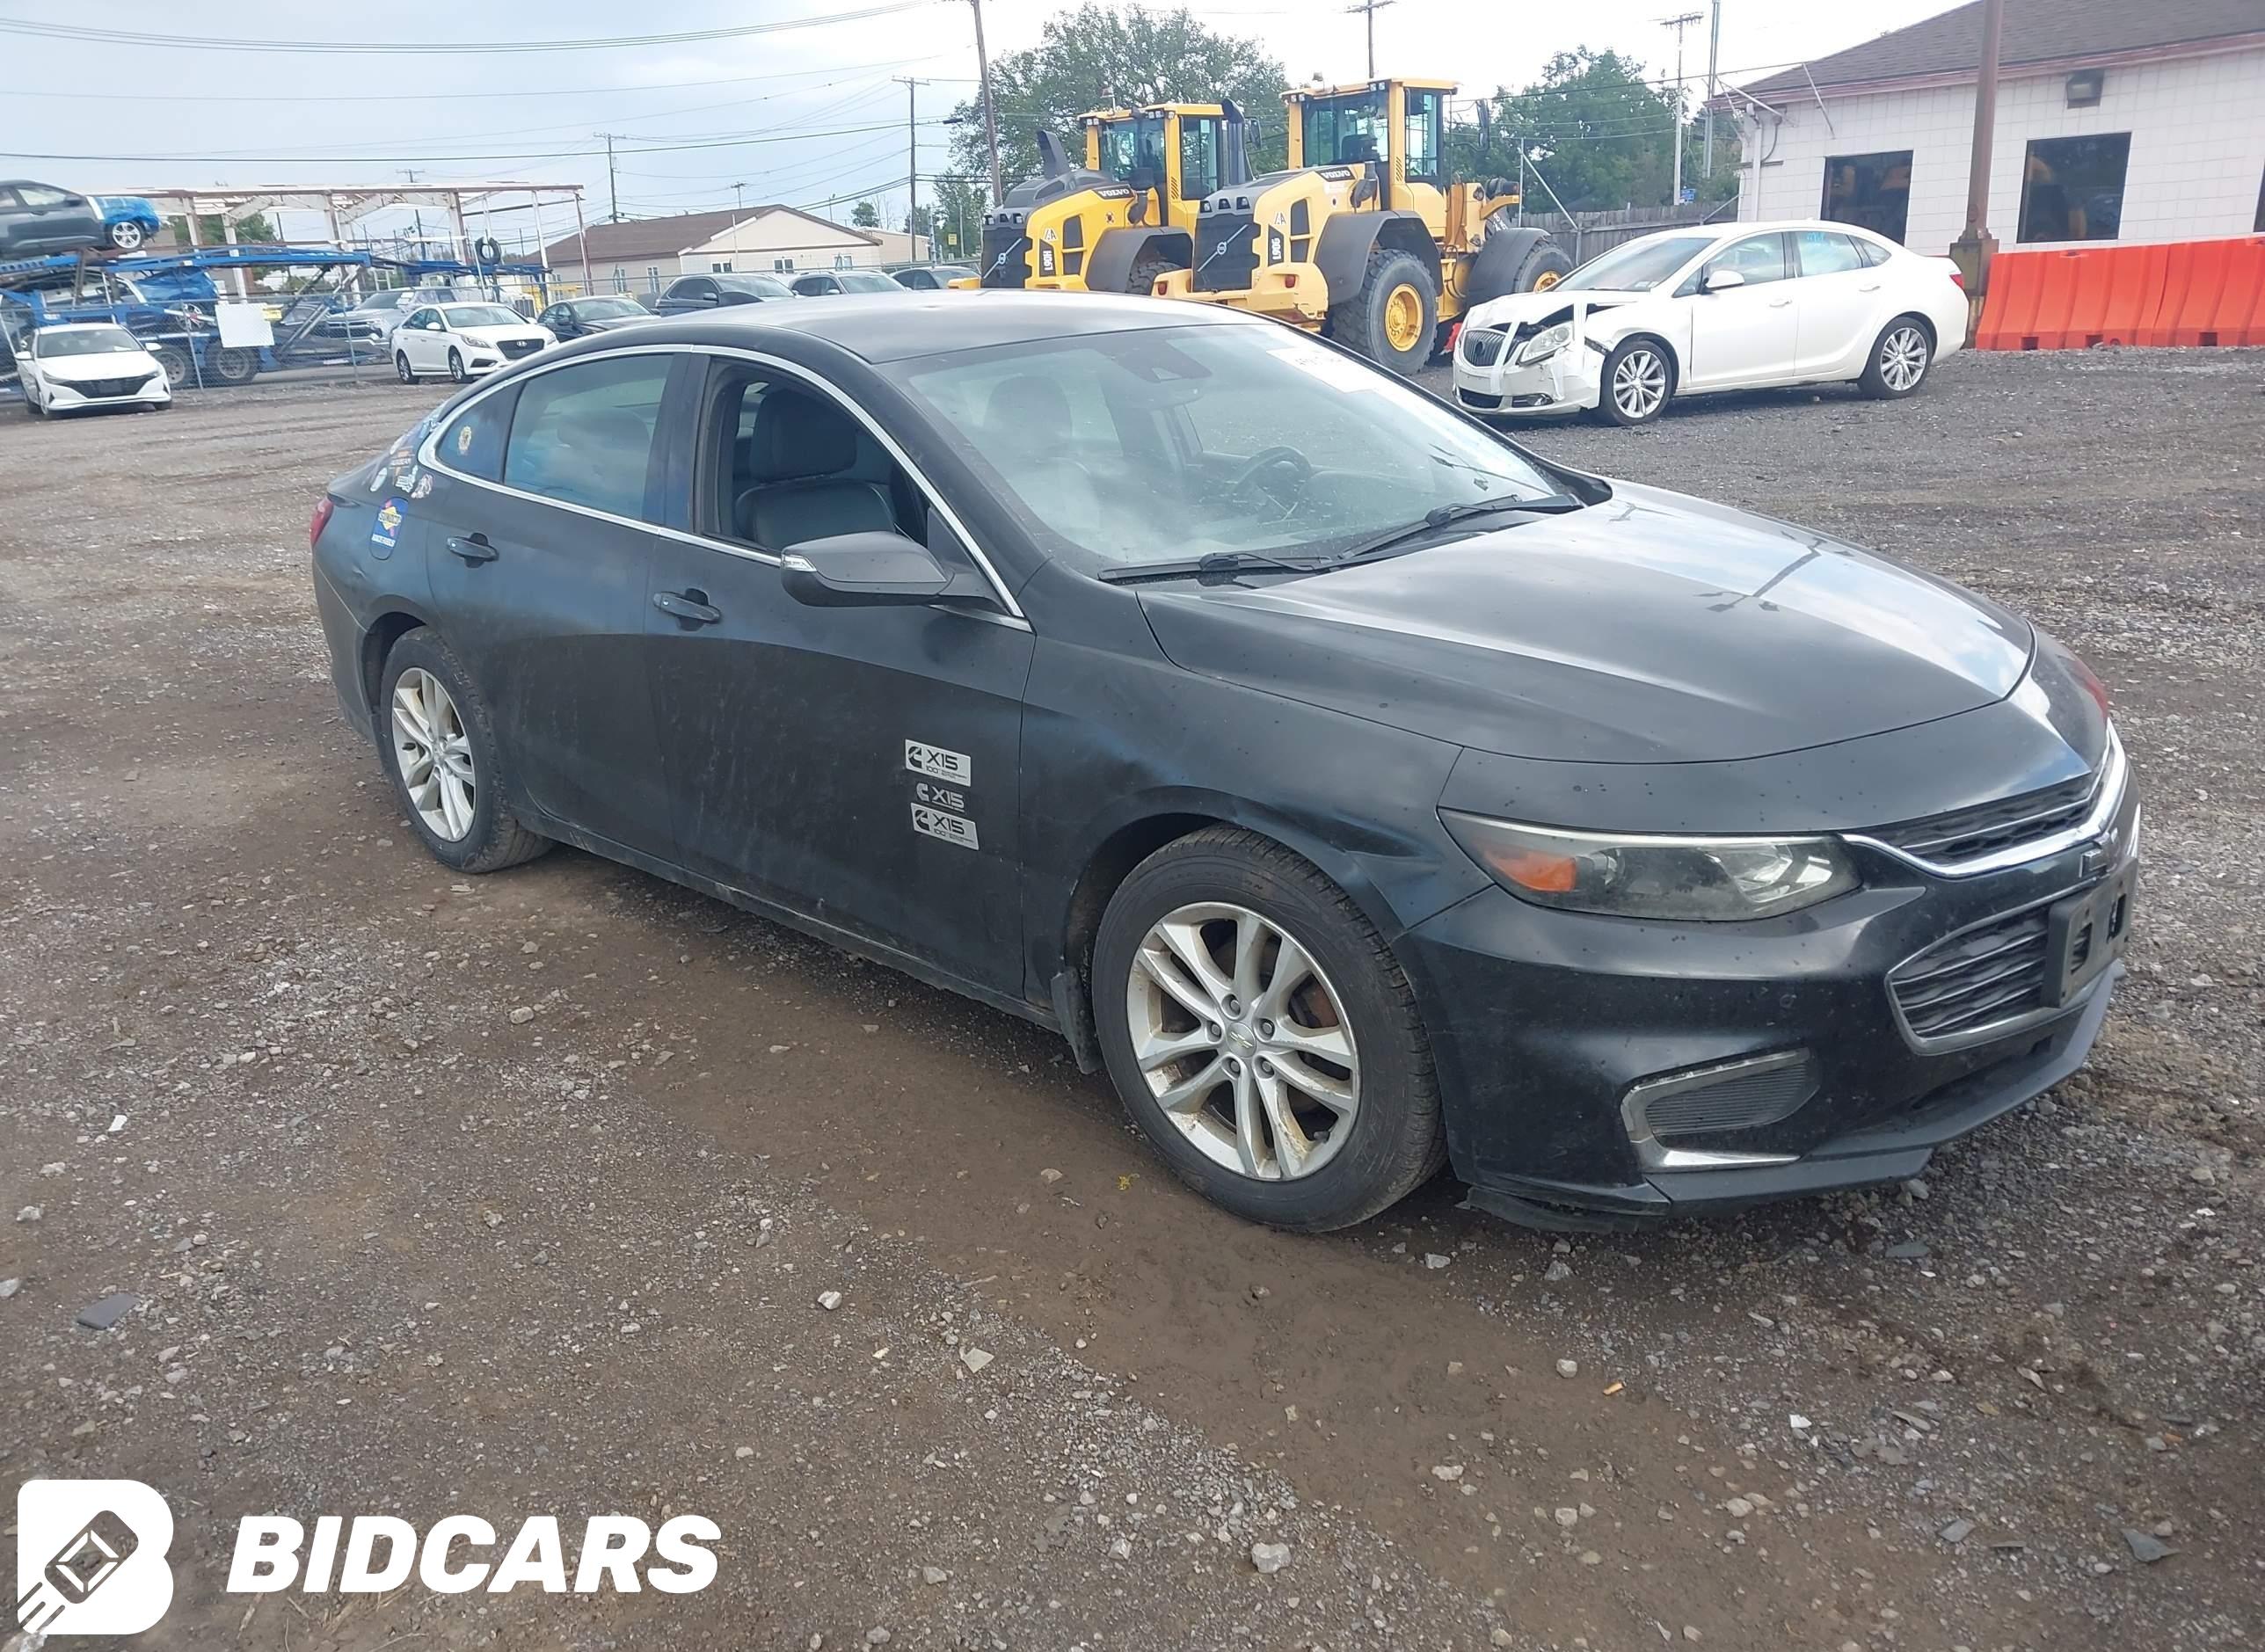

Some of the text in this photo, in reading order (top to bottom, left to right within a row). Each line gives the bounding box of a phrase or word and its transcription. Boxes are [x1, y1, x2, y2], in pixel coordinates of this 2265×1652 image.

[1321, 170, 1351, 178] VOLVO
[1098, 188, 1130, 197] VOLVO
[1043, 250, 1054, 271] L90H
[927, 748, 958, 771] X15
[932, 786, 965, 809] X15
[932, 813, 965, 835] X15
